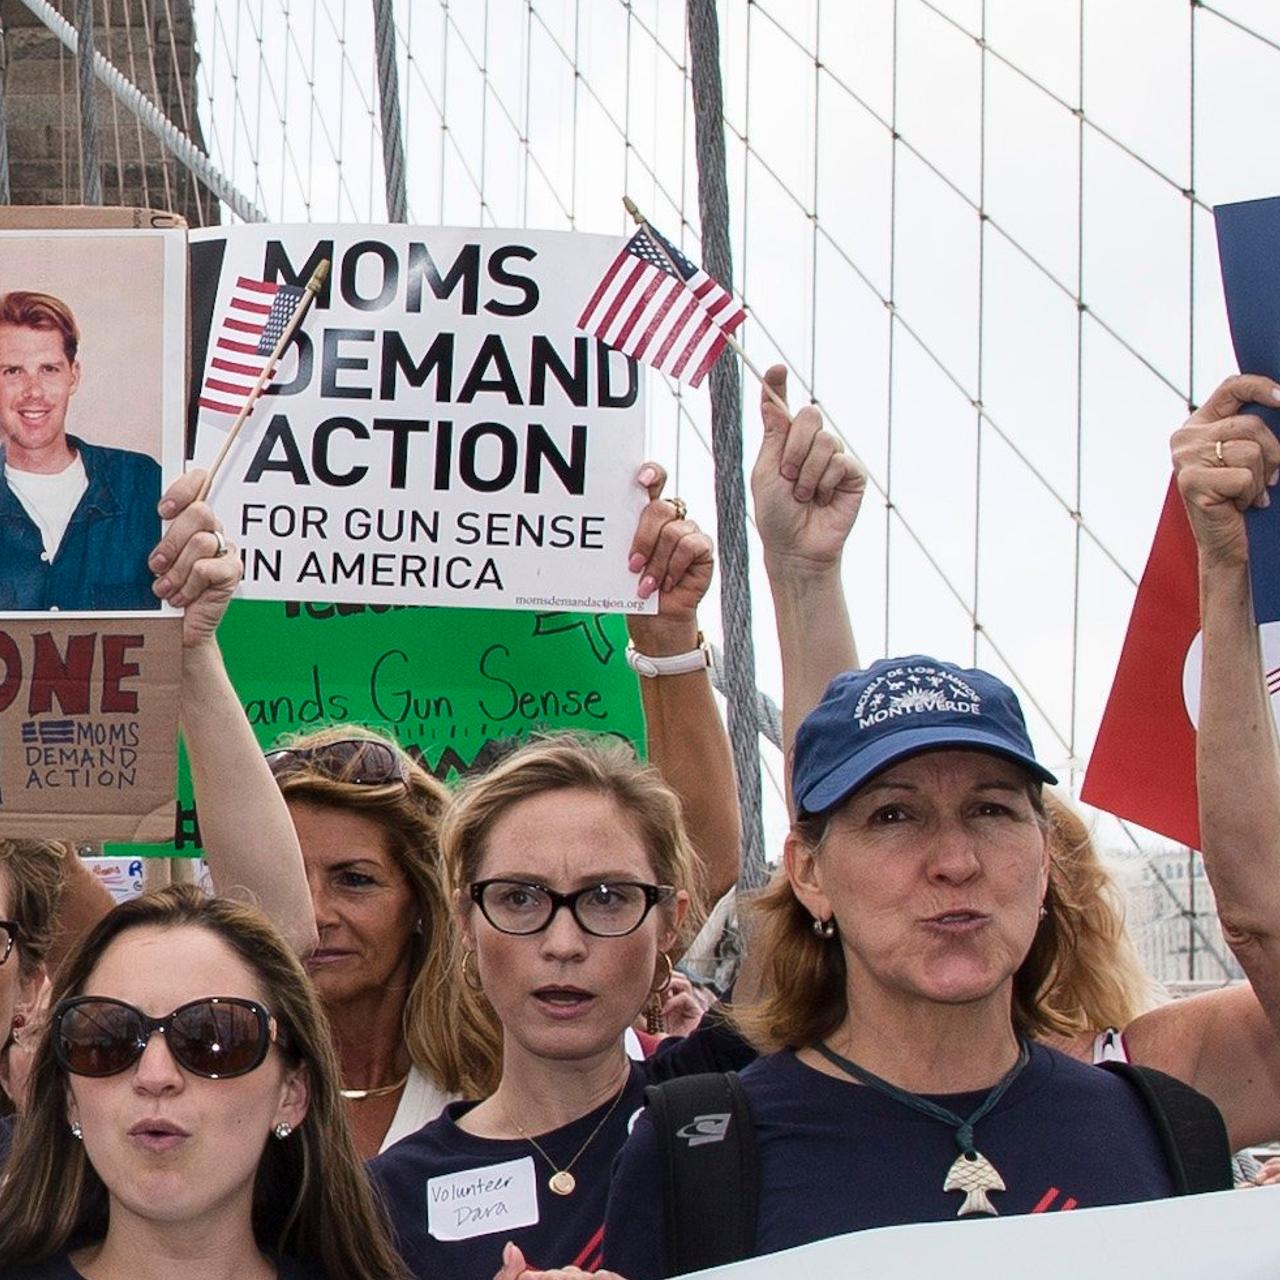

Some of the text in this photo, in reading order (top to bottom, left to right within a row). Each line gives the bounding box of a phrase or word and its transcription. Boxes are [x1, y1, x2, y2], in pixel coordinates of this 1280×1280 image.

[263, 240, 540, 317] MOMS
[262, 328, 639, 409] DEMAND
[243, 414, 588, 496] ACTION
[240, 503, 606, 550] FOR GUN SENSE
[239, 548, 505, 592] IN AMERICA
[370, 649, 453, 724] Gun
[479, 643, 609, 721] Sense
[858, 700, 982, 730] MONTEVERDE
[76, 721, 140, 747] MOMS
[25, 745, 138, 770] DEMAND
[25, 768, 137, 790] ACTION
[431, 1174, 514, 1204] Volunteer
[454, 1200, 509, 1227] Dara
